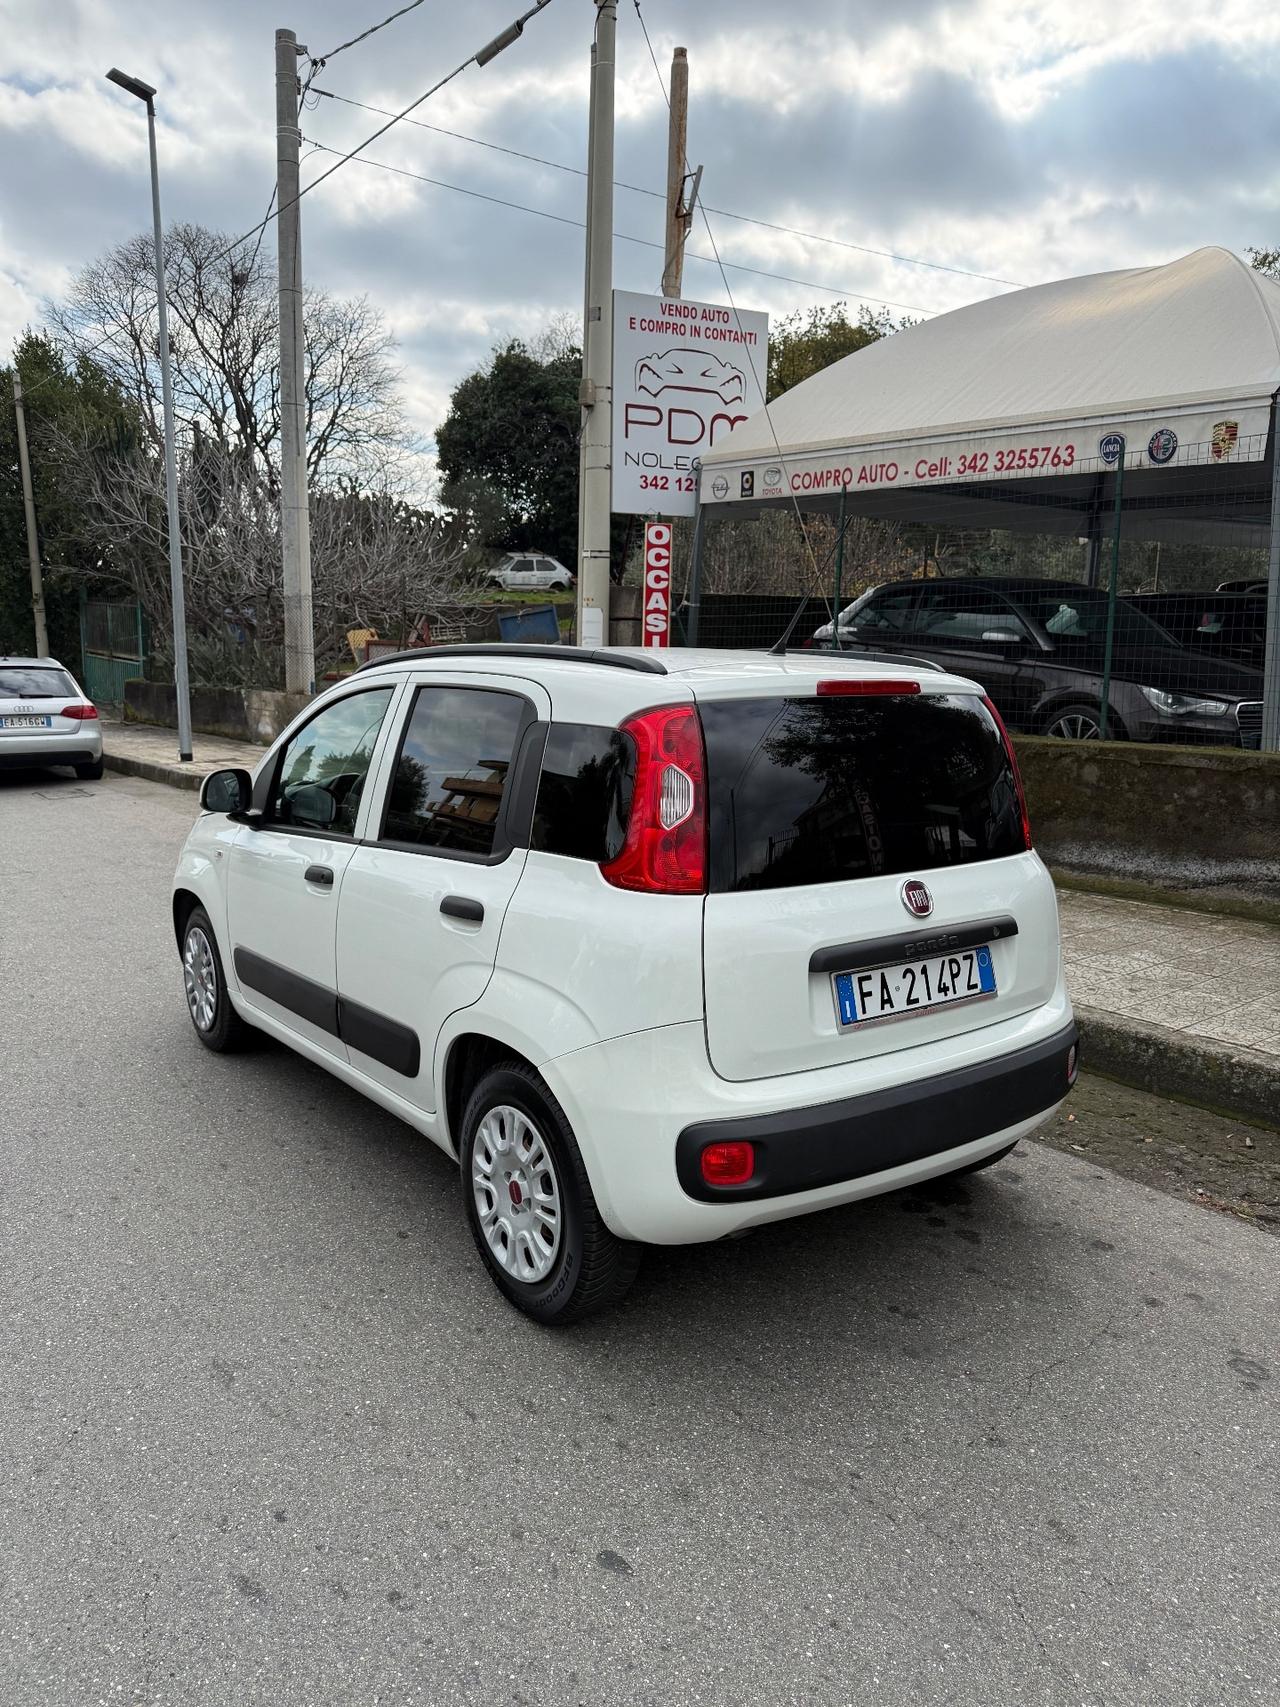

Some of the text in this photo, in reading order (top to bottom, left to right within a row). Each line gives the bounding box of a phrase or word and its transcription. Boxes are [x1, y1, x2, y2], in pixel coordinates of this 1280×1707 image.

[660, 303, 730, 323] VENDO AUTO
[629, 317, 757, 345] E COMPRO IN CONTANTI
[791, 467, 853, 491] COMPRO
[857, 462, 899, 484] AUTO
[915, 457, 952, 479] Cell:
[957, 452, 988, 475] 342
[994, 444, 1075, 472] 3255763
[640, 474, 698, 492] 342 12
[762, 487, 783, 496] TOYOTA
[909, 889, 928, 908] FIAT
